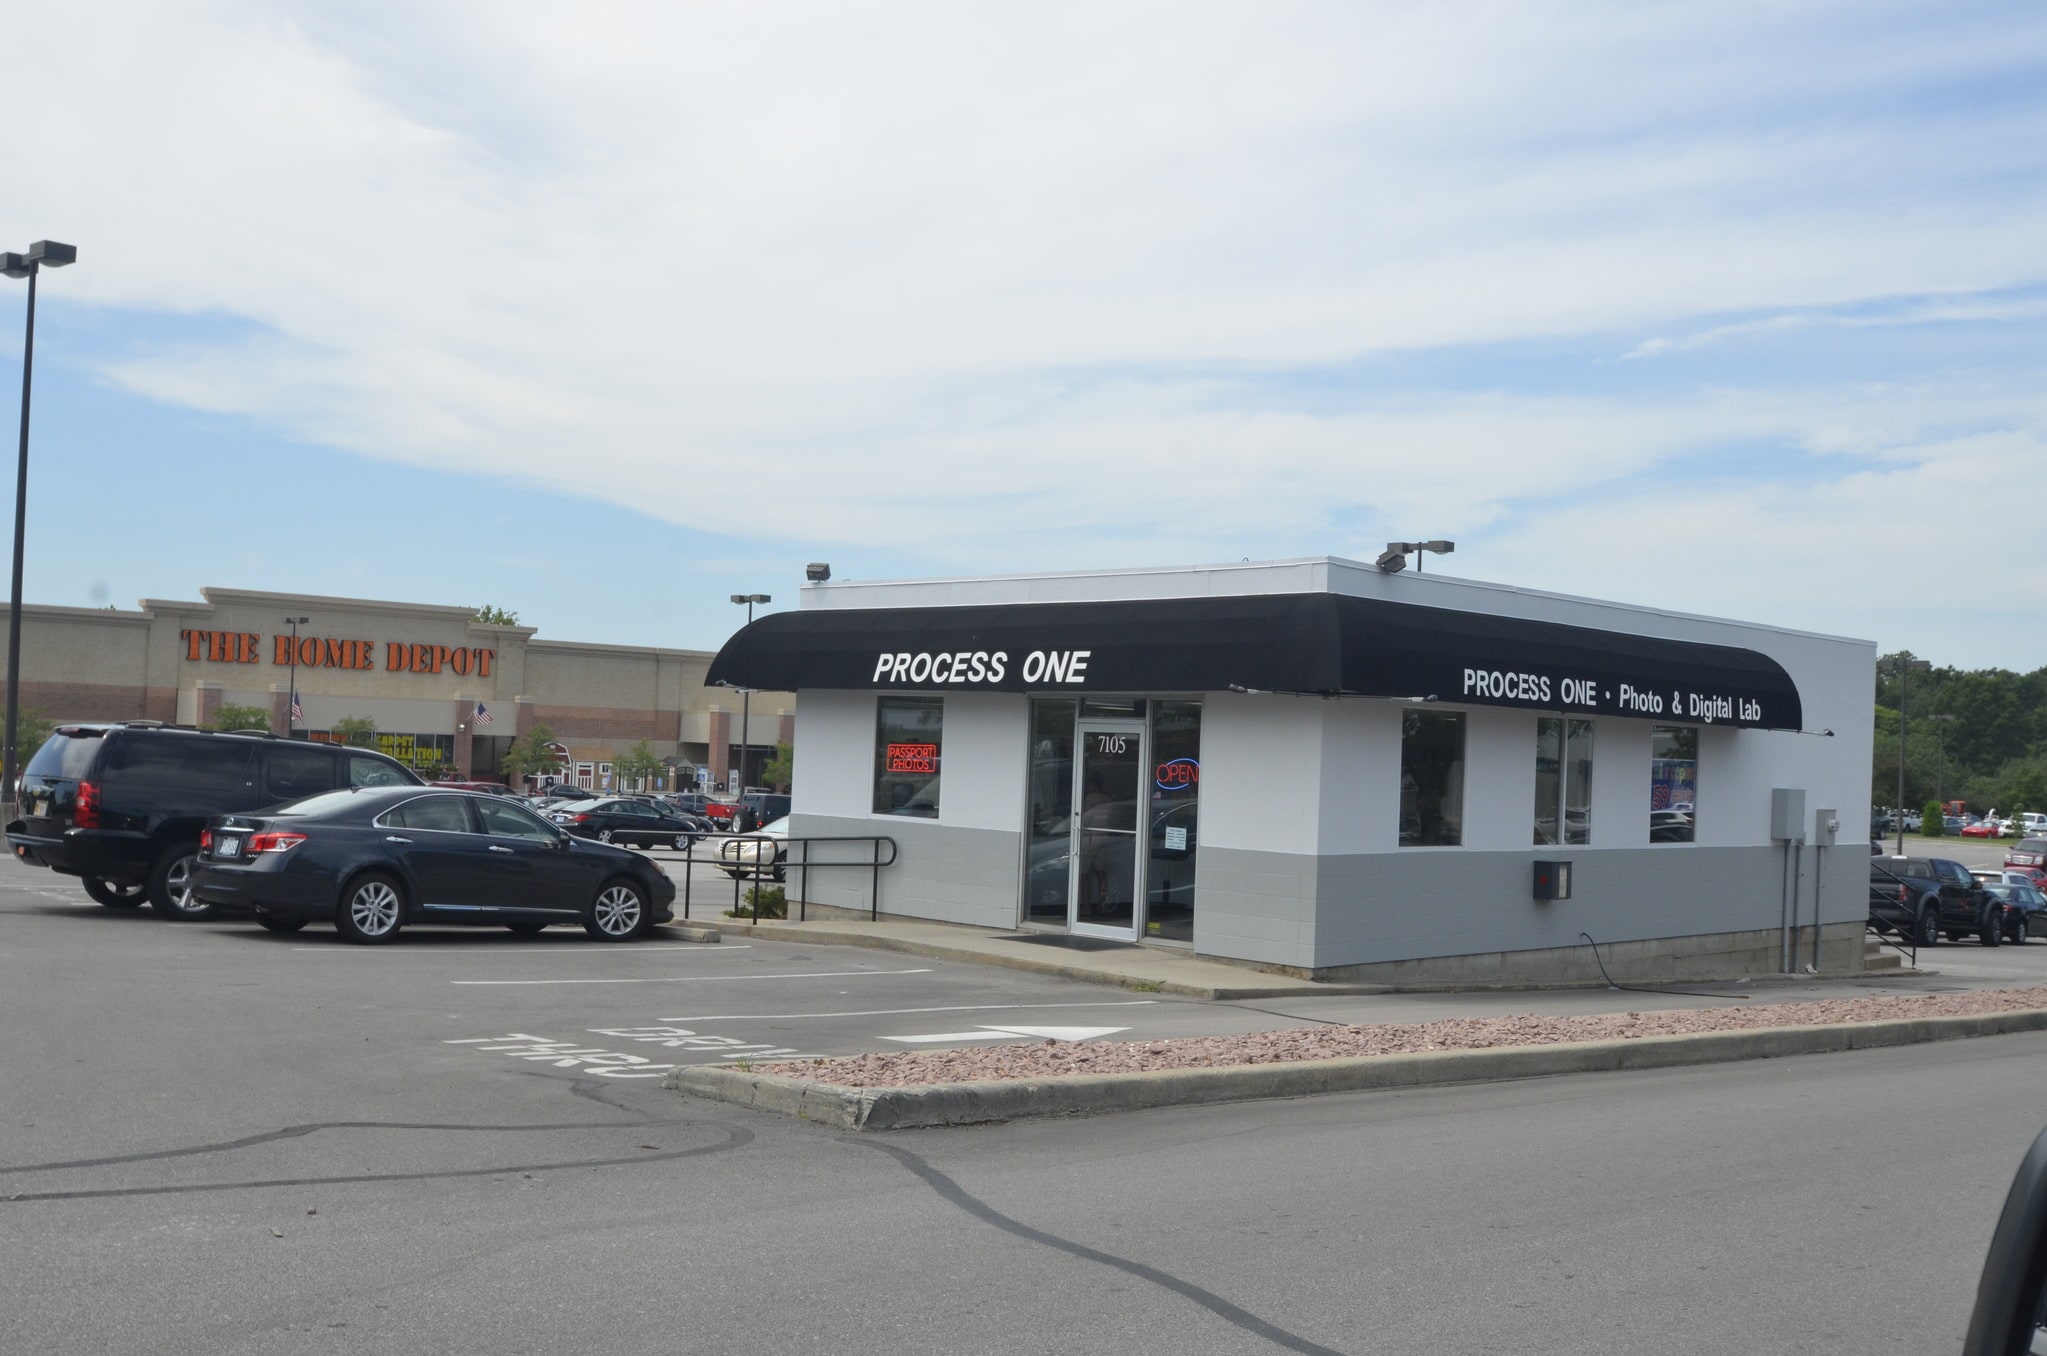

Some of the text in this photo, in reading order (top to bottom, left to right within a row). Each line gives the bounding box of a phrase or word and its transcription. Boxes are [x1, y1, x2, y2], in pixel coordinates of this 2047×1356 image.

[181, 629, 496, 677] THE HOME DEPOT
[872, 650, 1092, 683] PROCESS ONE
[1463, 668, 1761, 723] PROCESS ONE Photo & Digital Lab
[889, 747, 934, 759] PASSPORT
[1098, 735, 1126, 754] 7105
[893, 759, 930, 770] PHOTOS
[1156, 763, 1200, 783] OPEN
[1651, 784, 1670, 810] 59
[442, 1032, 676, 1078] THRU
[586, 1025, 830, 1059] DRIV
